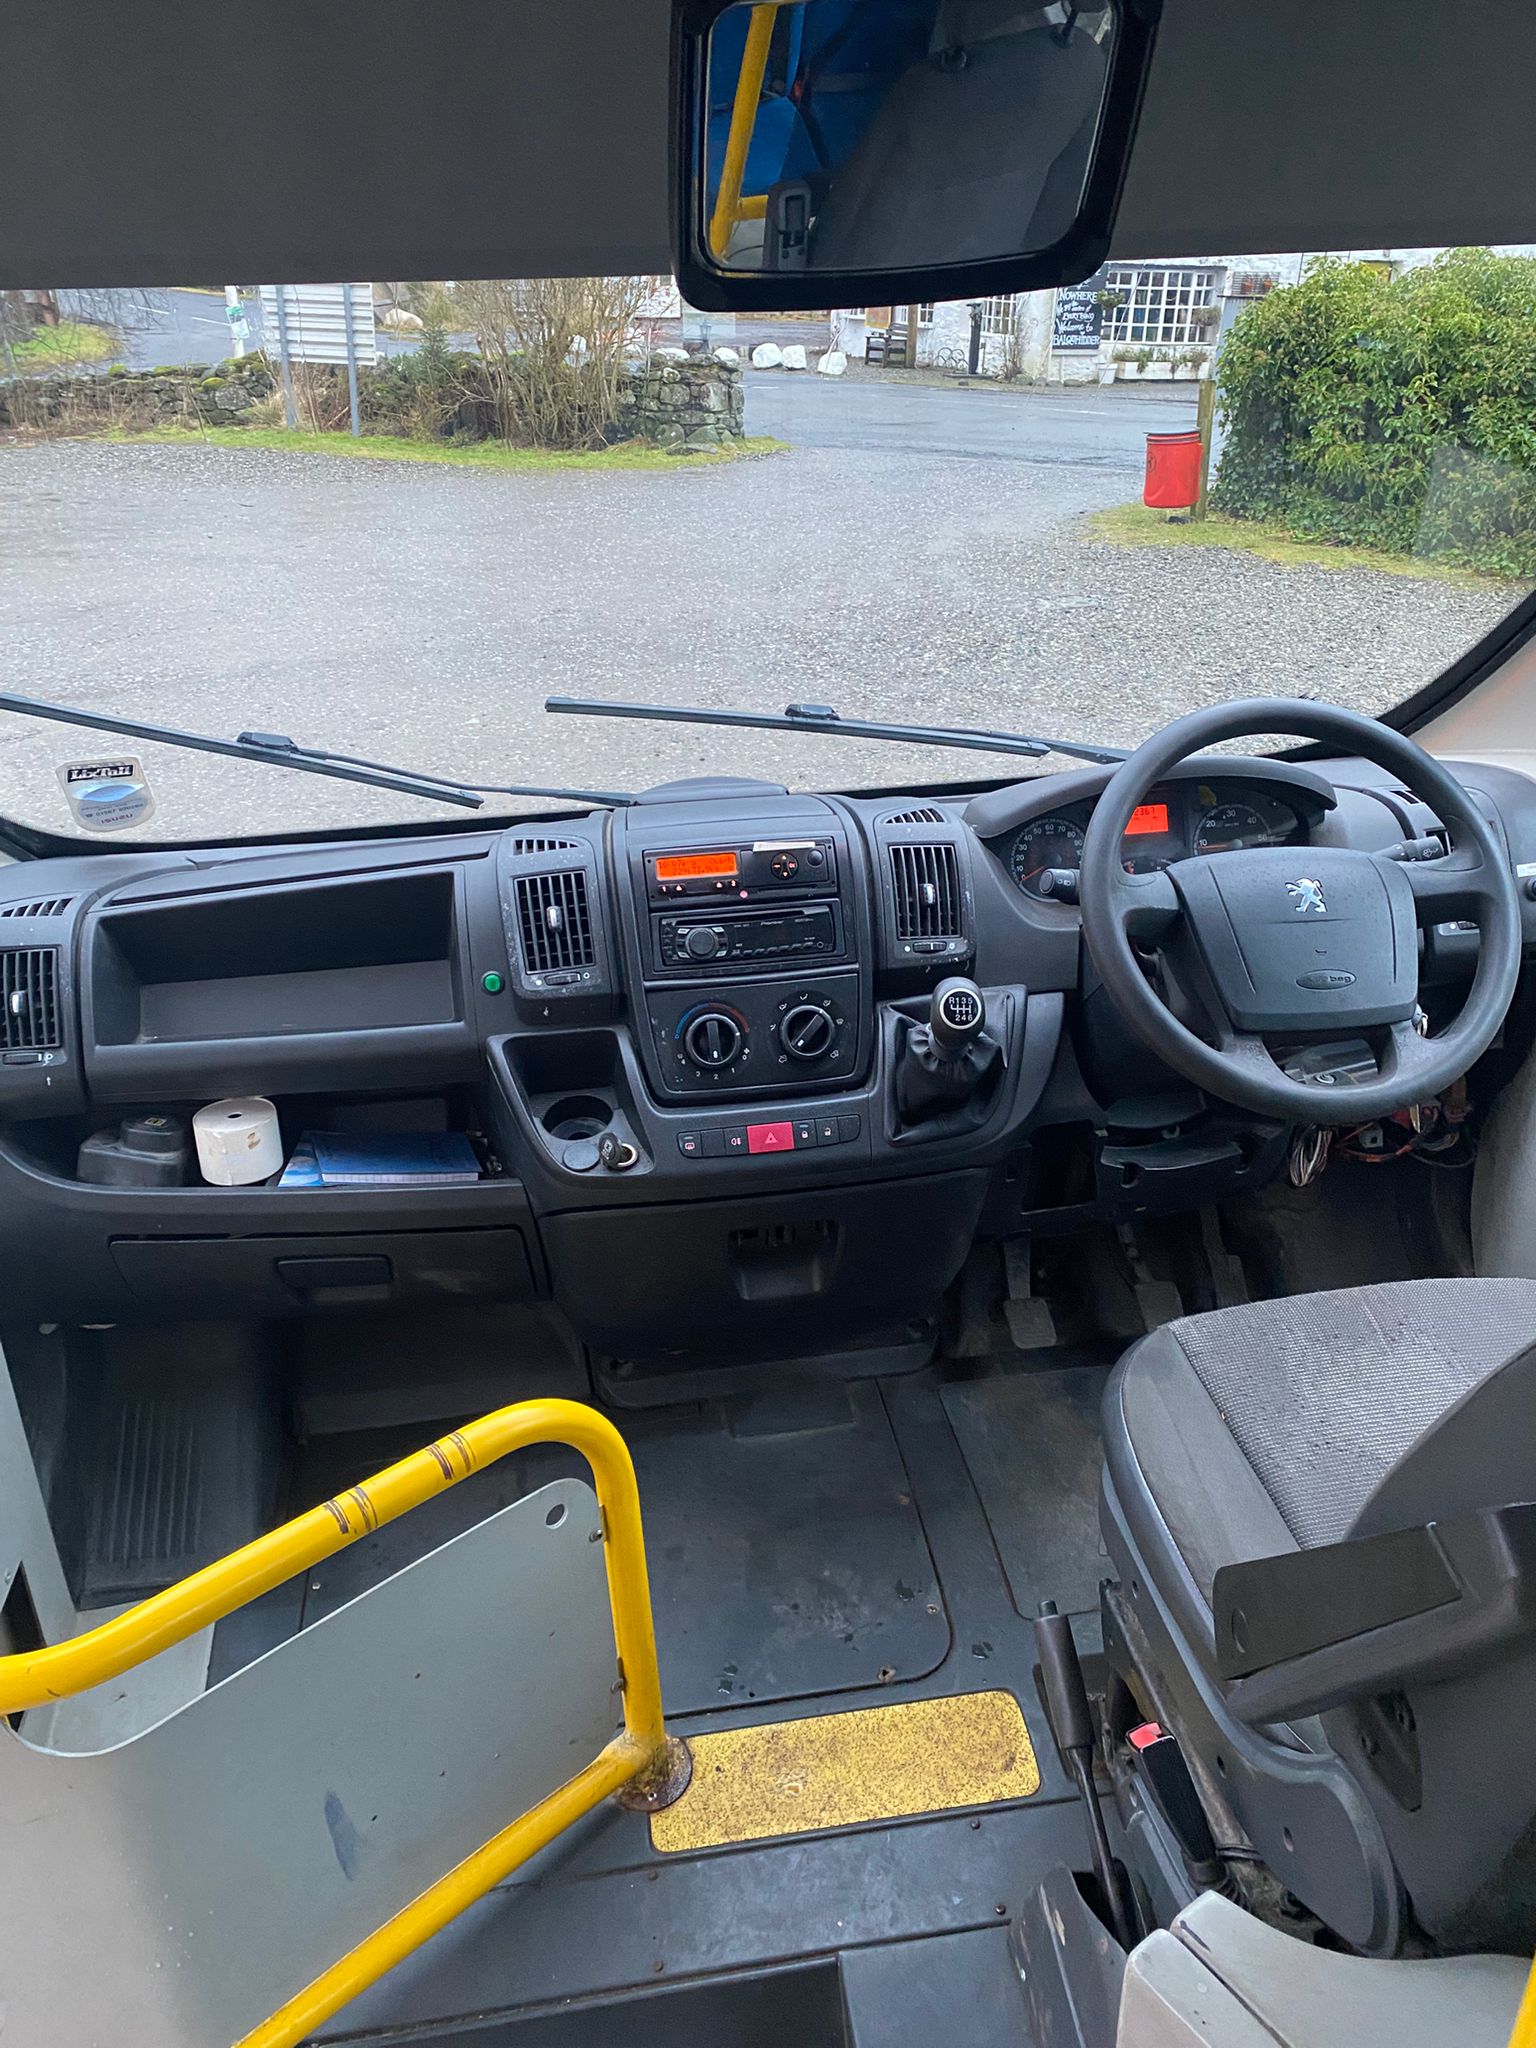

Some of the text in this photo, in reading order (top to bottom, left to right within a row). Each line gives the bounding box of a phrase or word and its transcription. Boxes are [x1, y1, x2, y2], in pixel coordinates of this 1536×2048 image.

[1059, 288, 1098, 304] NOWHERE
[1056, 318, 1094, 334] Welcome to
[1226, 809, 1237, 818] 30
[1206, 819, 1216, 828] 20
[1247, 816, 1257, 825] 40
[1045, 823, 1054, 831] 60
[1018, 843, 1028, 851] 30
[1073, 839, 1083, 847] 90
[949, 996, 955, 1004] R
